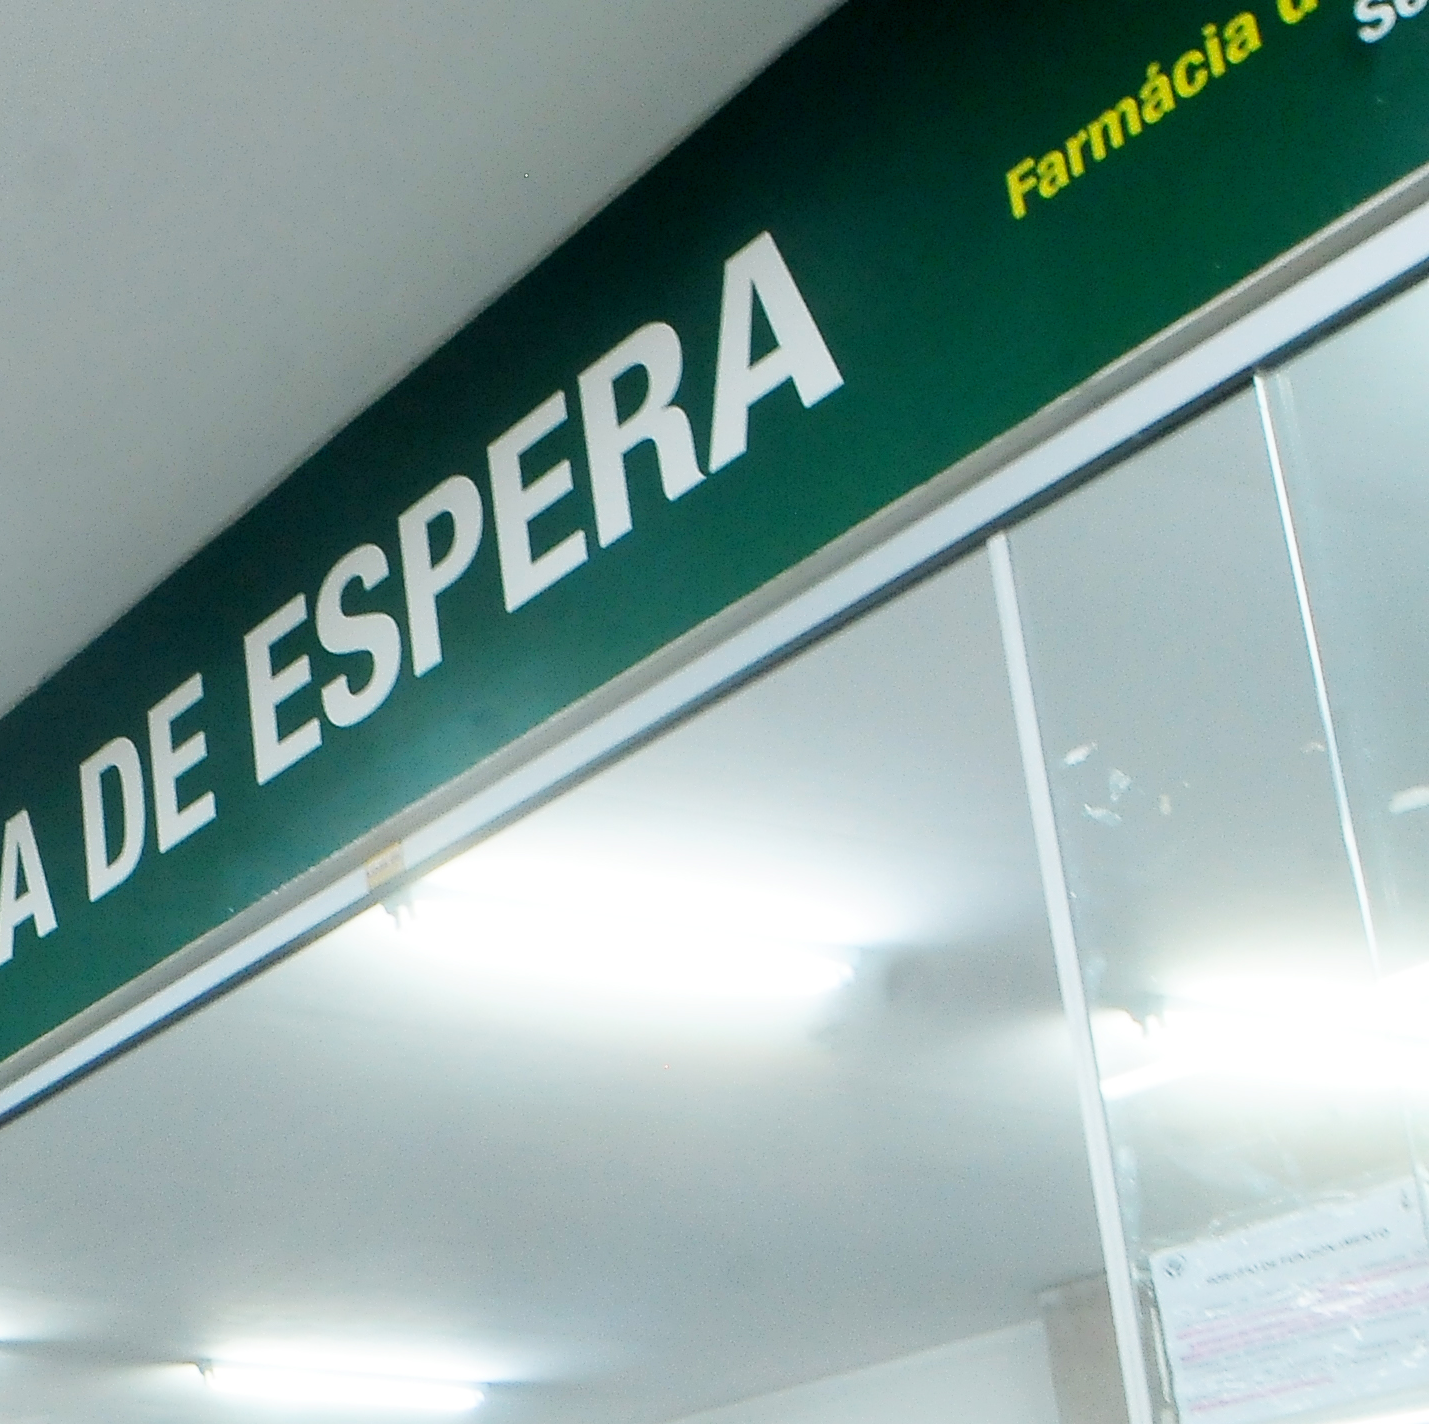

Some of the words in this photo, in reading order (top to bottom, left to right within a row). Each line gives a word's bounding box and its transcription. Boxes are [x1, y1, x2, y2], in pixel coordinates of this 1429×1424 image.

[1006, 11, 1263, 219] Farmácia
[79, 672, 217, 902] DE
[243, 231, 845, 786] ESPERA
